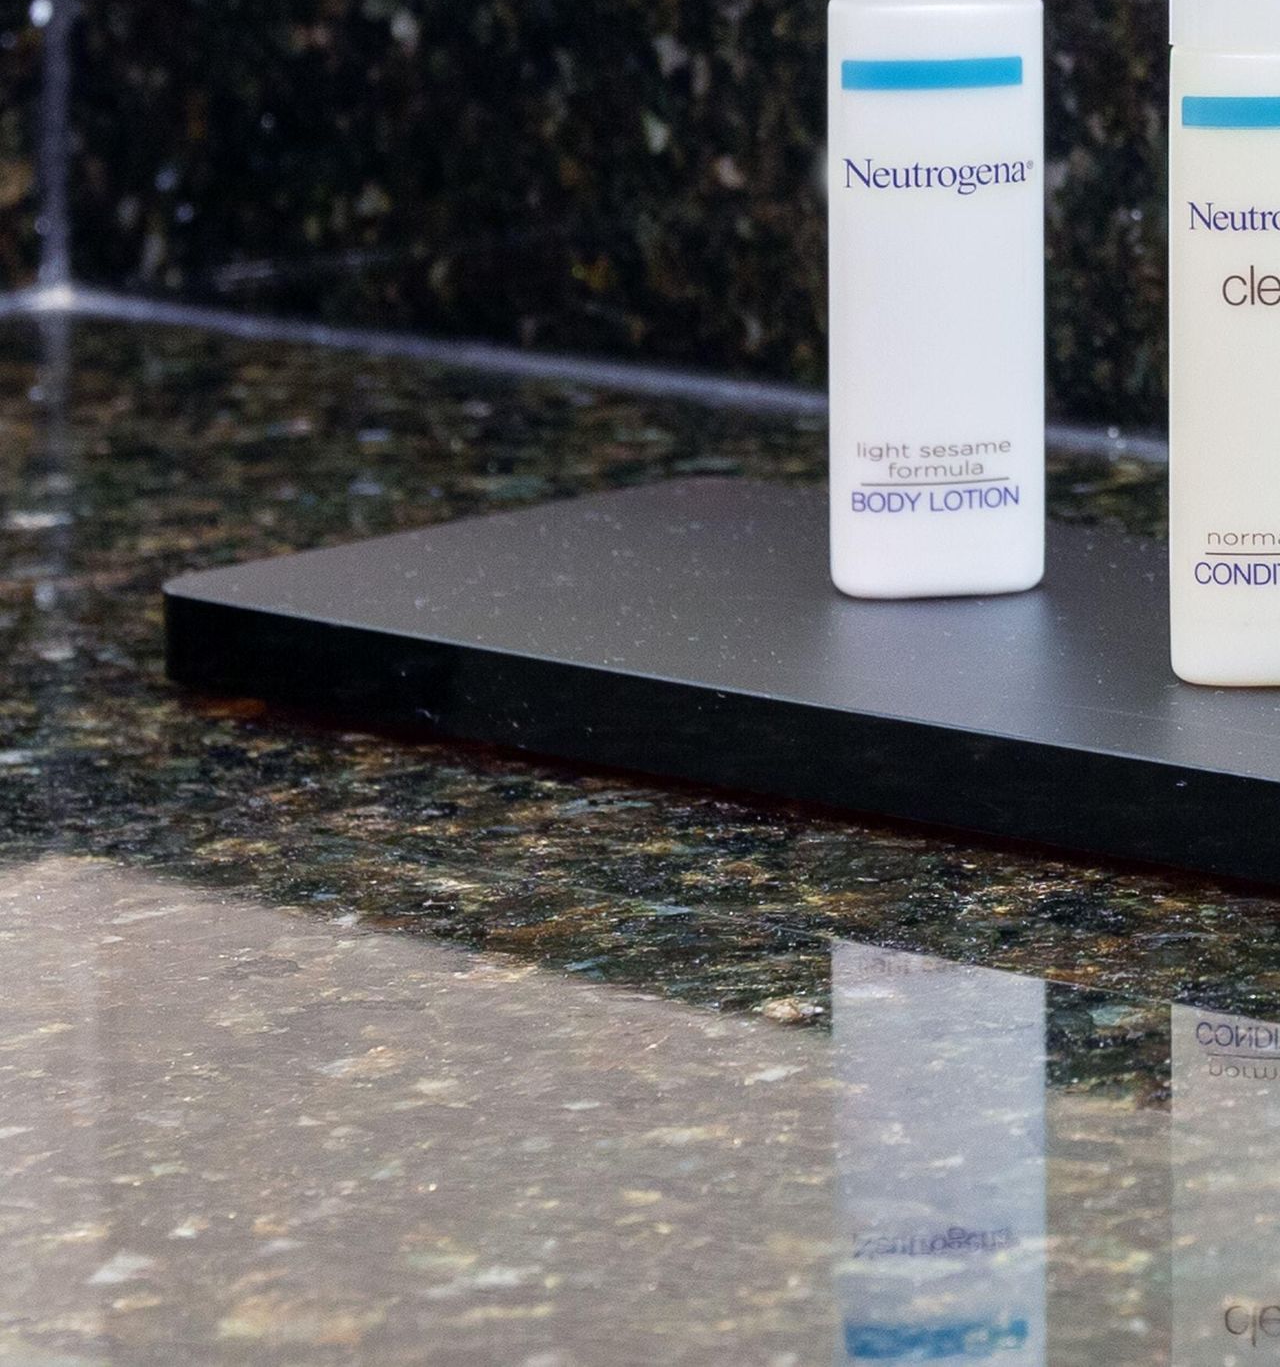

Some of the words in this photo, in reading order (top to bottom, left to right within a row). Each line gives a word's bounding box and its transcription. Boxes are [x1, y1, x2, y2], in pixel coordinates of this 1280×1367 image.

[856, 441, 911, 463] light
[919, 439, 1012, 458] sesame
[888, 459, 985, 480] formula
[851, 491, 922, 513] BODY
[929, 485, 1020, 513] LOTION
